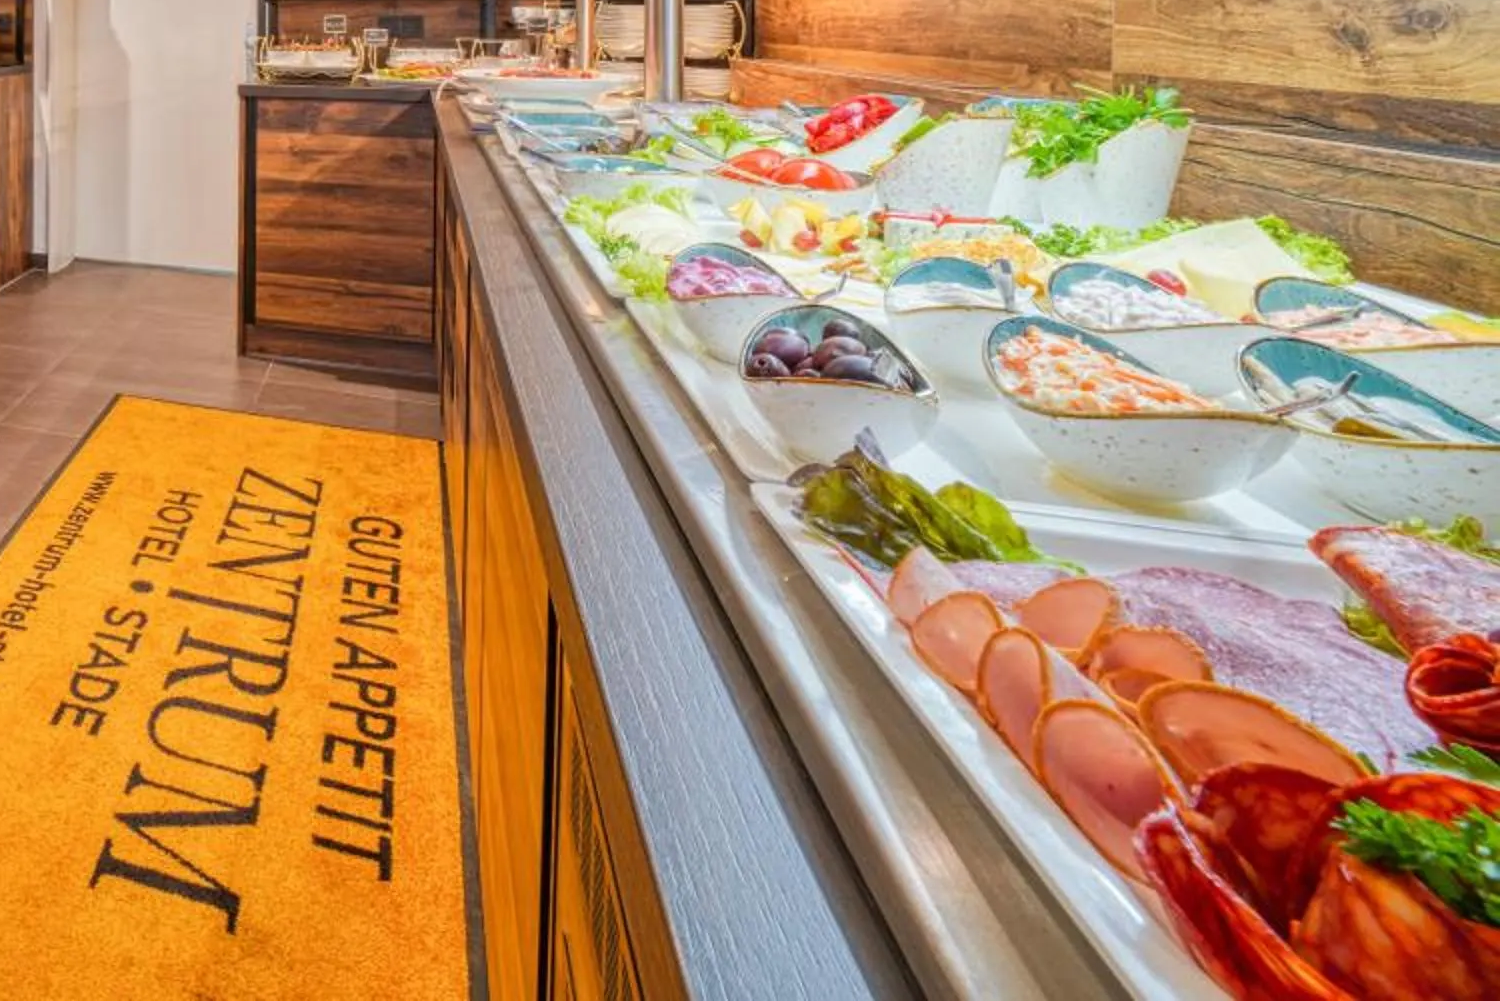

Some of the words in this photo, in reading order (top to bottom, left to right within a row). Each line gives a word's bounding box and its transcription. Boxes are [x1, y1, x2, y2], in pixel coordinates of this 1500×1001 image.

[130, 489, 203, 567] HOTEL
[339, 513, 404, 636] GUTEN
[49, 605, 149, 738] STADE
[88, 466, 324, 936] ZENTRUM
[311, 636, 398, 883] APPETIT
